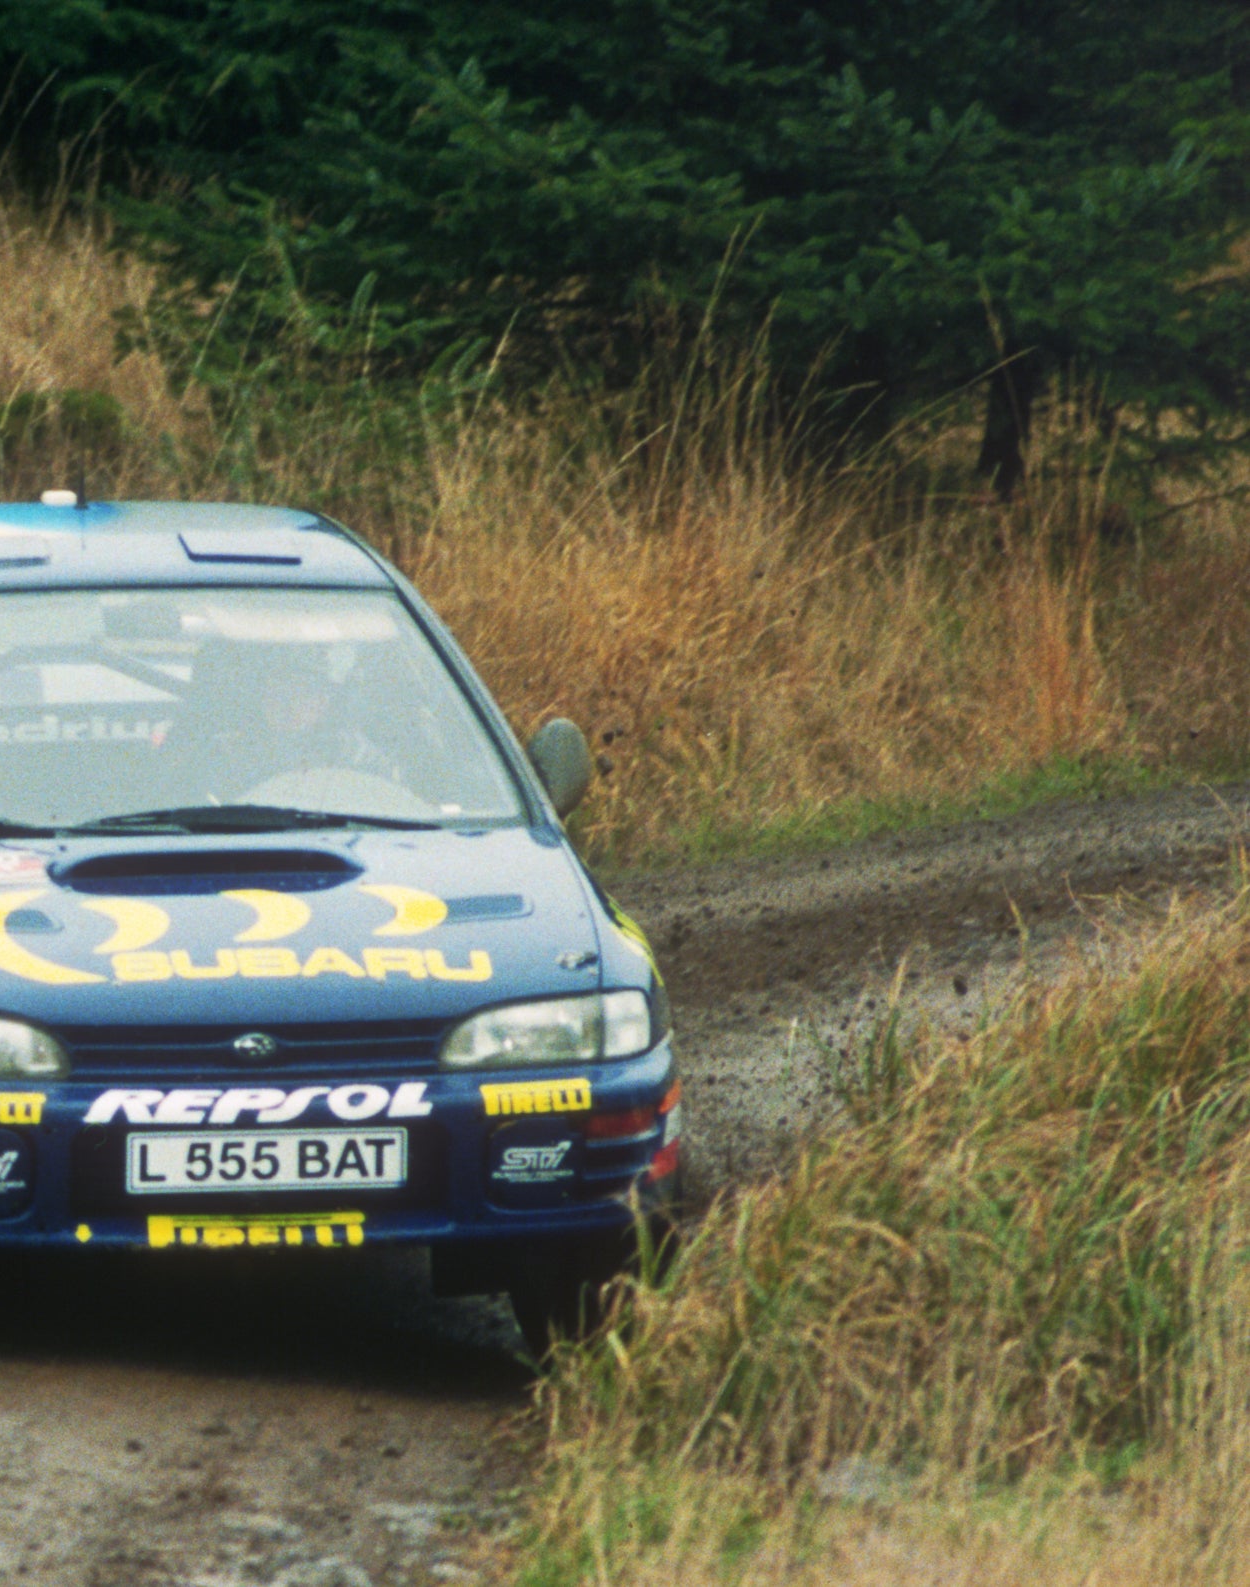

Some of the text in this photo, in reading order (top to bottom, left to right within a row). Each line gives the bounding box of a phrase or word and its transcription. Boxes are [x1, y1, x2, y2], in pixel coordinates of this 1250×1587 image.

[111, 947, 493, 982] SUBARU
[83, 1082, 433, 1124] REPSOL
[480, 1078, 593, 1116] PIRELLI
[138, 1138, 396, 1182] L 555 BAT
